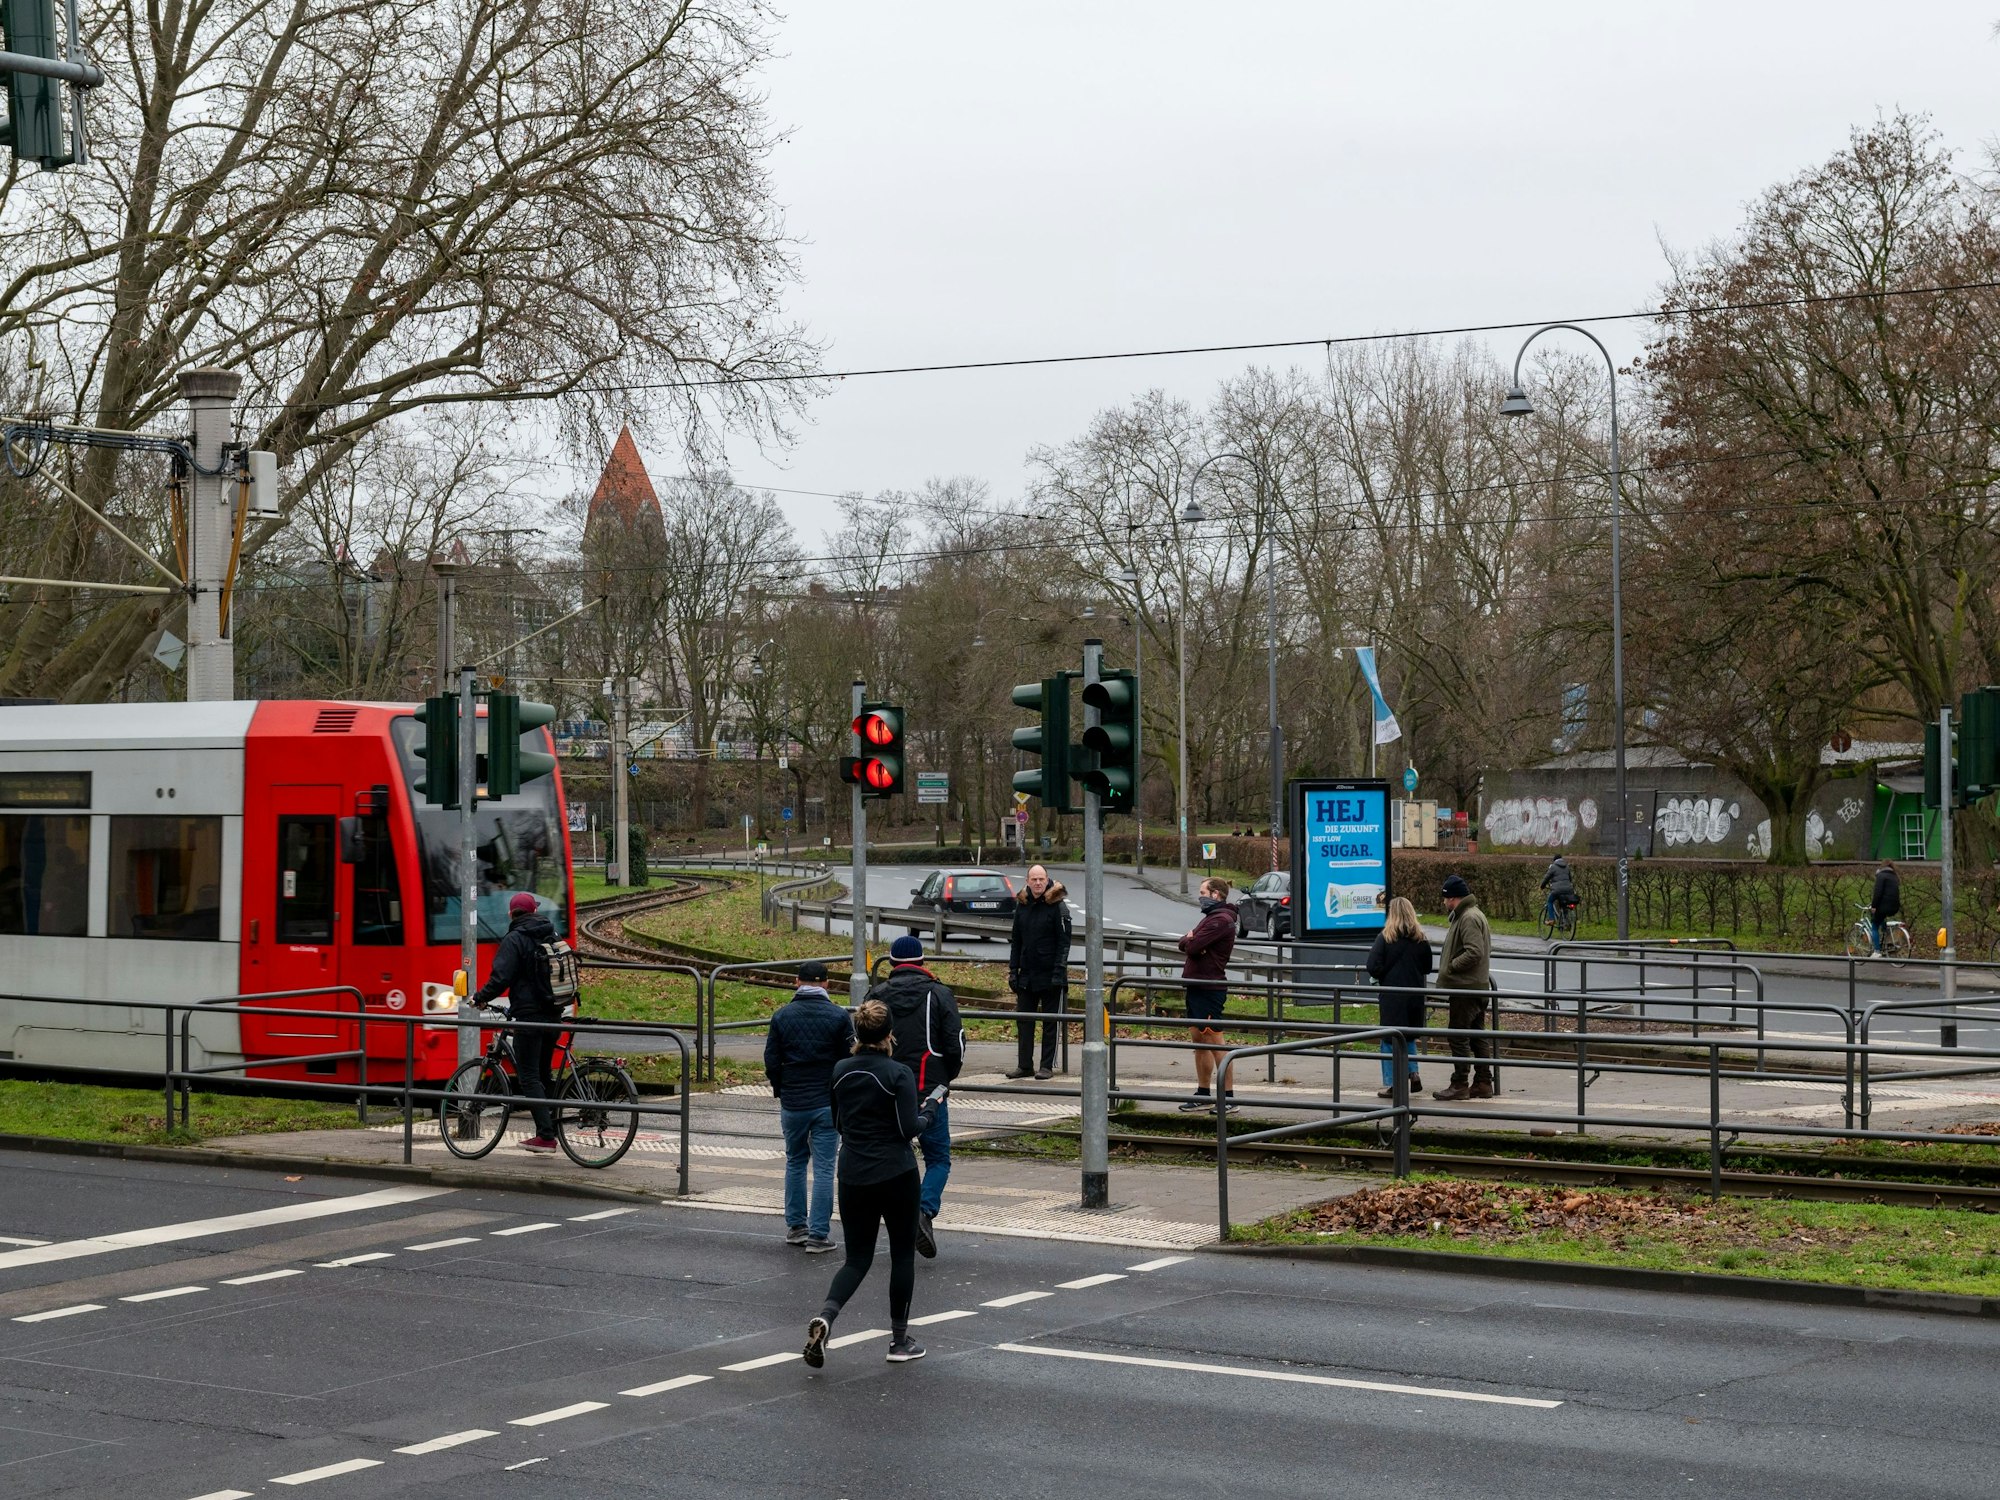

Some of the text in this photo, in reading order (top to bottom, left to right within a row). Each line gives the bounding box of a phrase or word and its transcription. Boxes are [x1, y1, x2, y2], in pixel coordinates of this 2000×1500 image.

[781, 758, 785, 767] 2
[1324, 824, 1380, 834] DIE ZUKUNFT
[1321, 844, 1373, 857] SUGAR.
